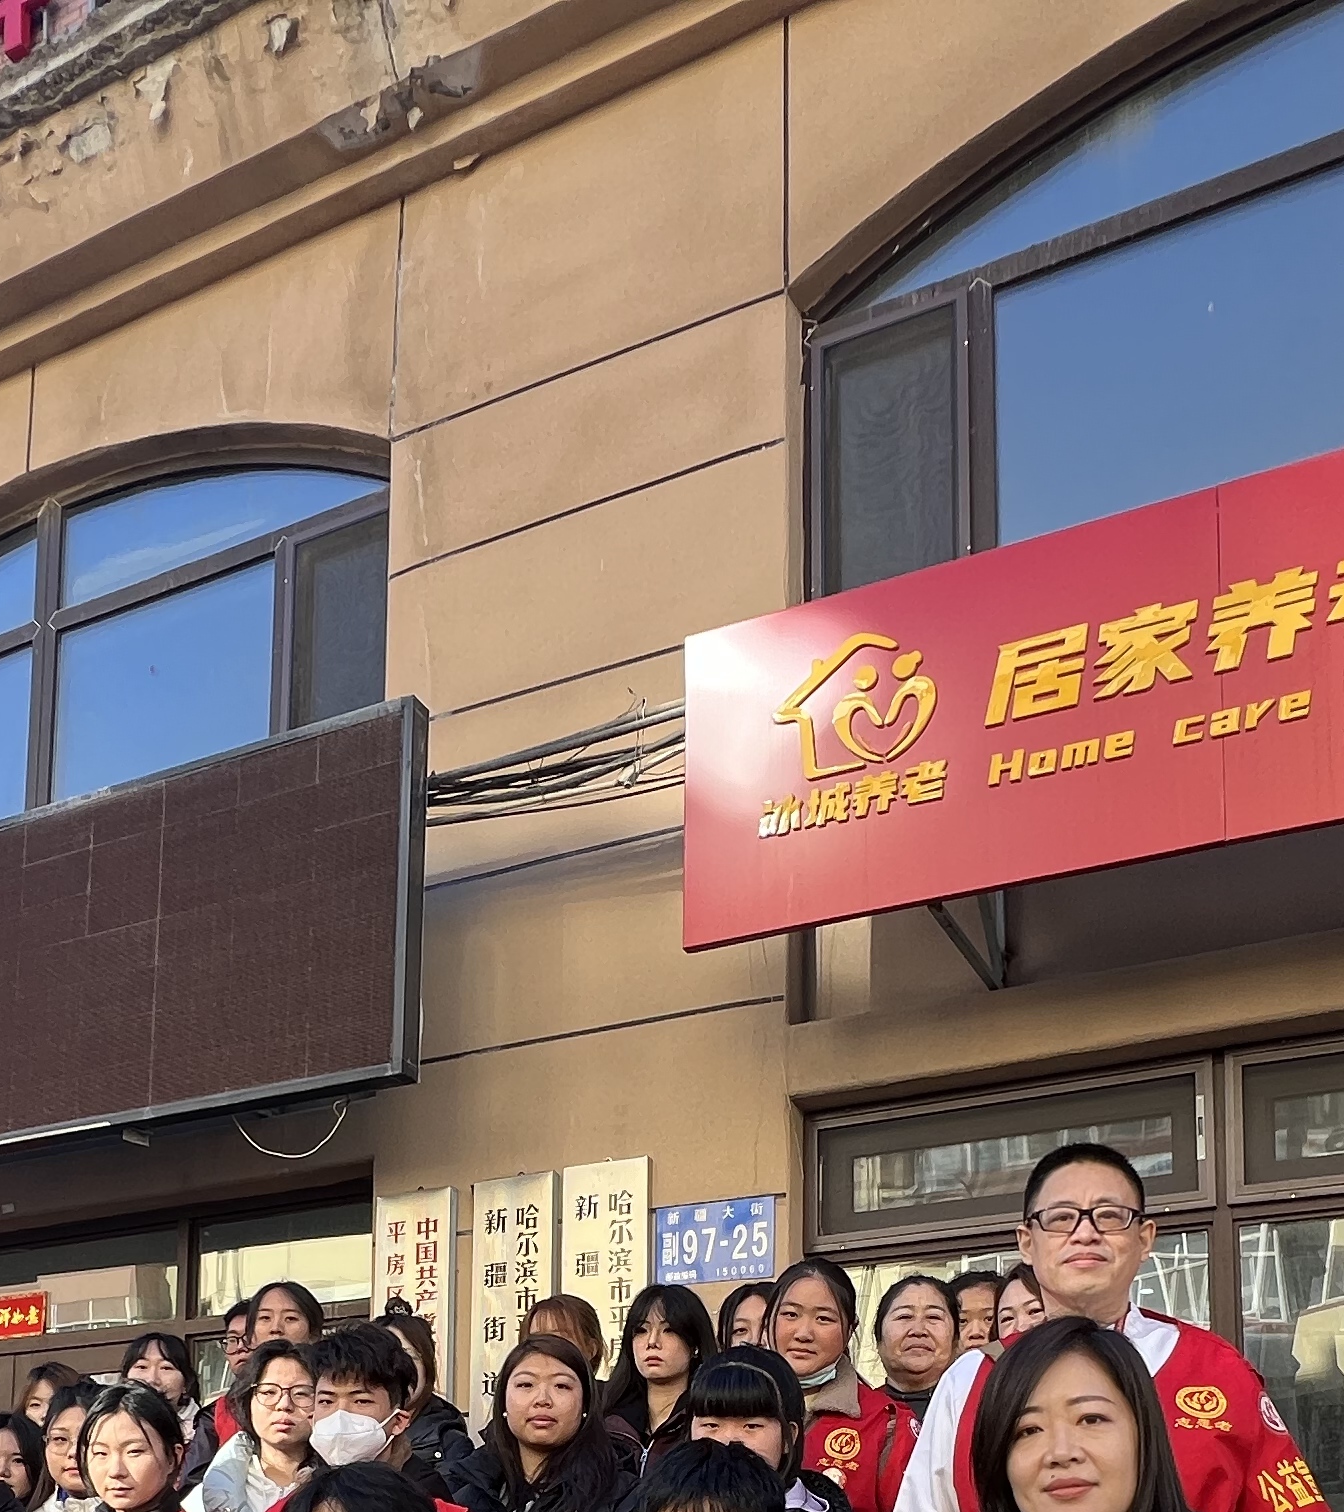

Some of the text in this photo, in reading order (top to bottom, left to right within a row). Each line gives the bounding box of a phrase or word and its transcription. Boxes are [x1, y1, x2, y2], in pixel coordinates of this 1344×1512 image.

[988, 728, 1134, 786] Home
[1173, 690, 1311, 748] care
[758, 759, 947, 839] 冰城养老
[575, 1193, 600, 1278] 新疆
[661, 1221, 768, 1267] 副97-25
[666, 1202, 764, 1226] 新疆大街
[716, 1263, 765, 1277] 150060
